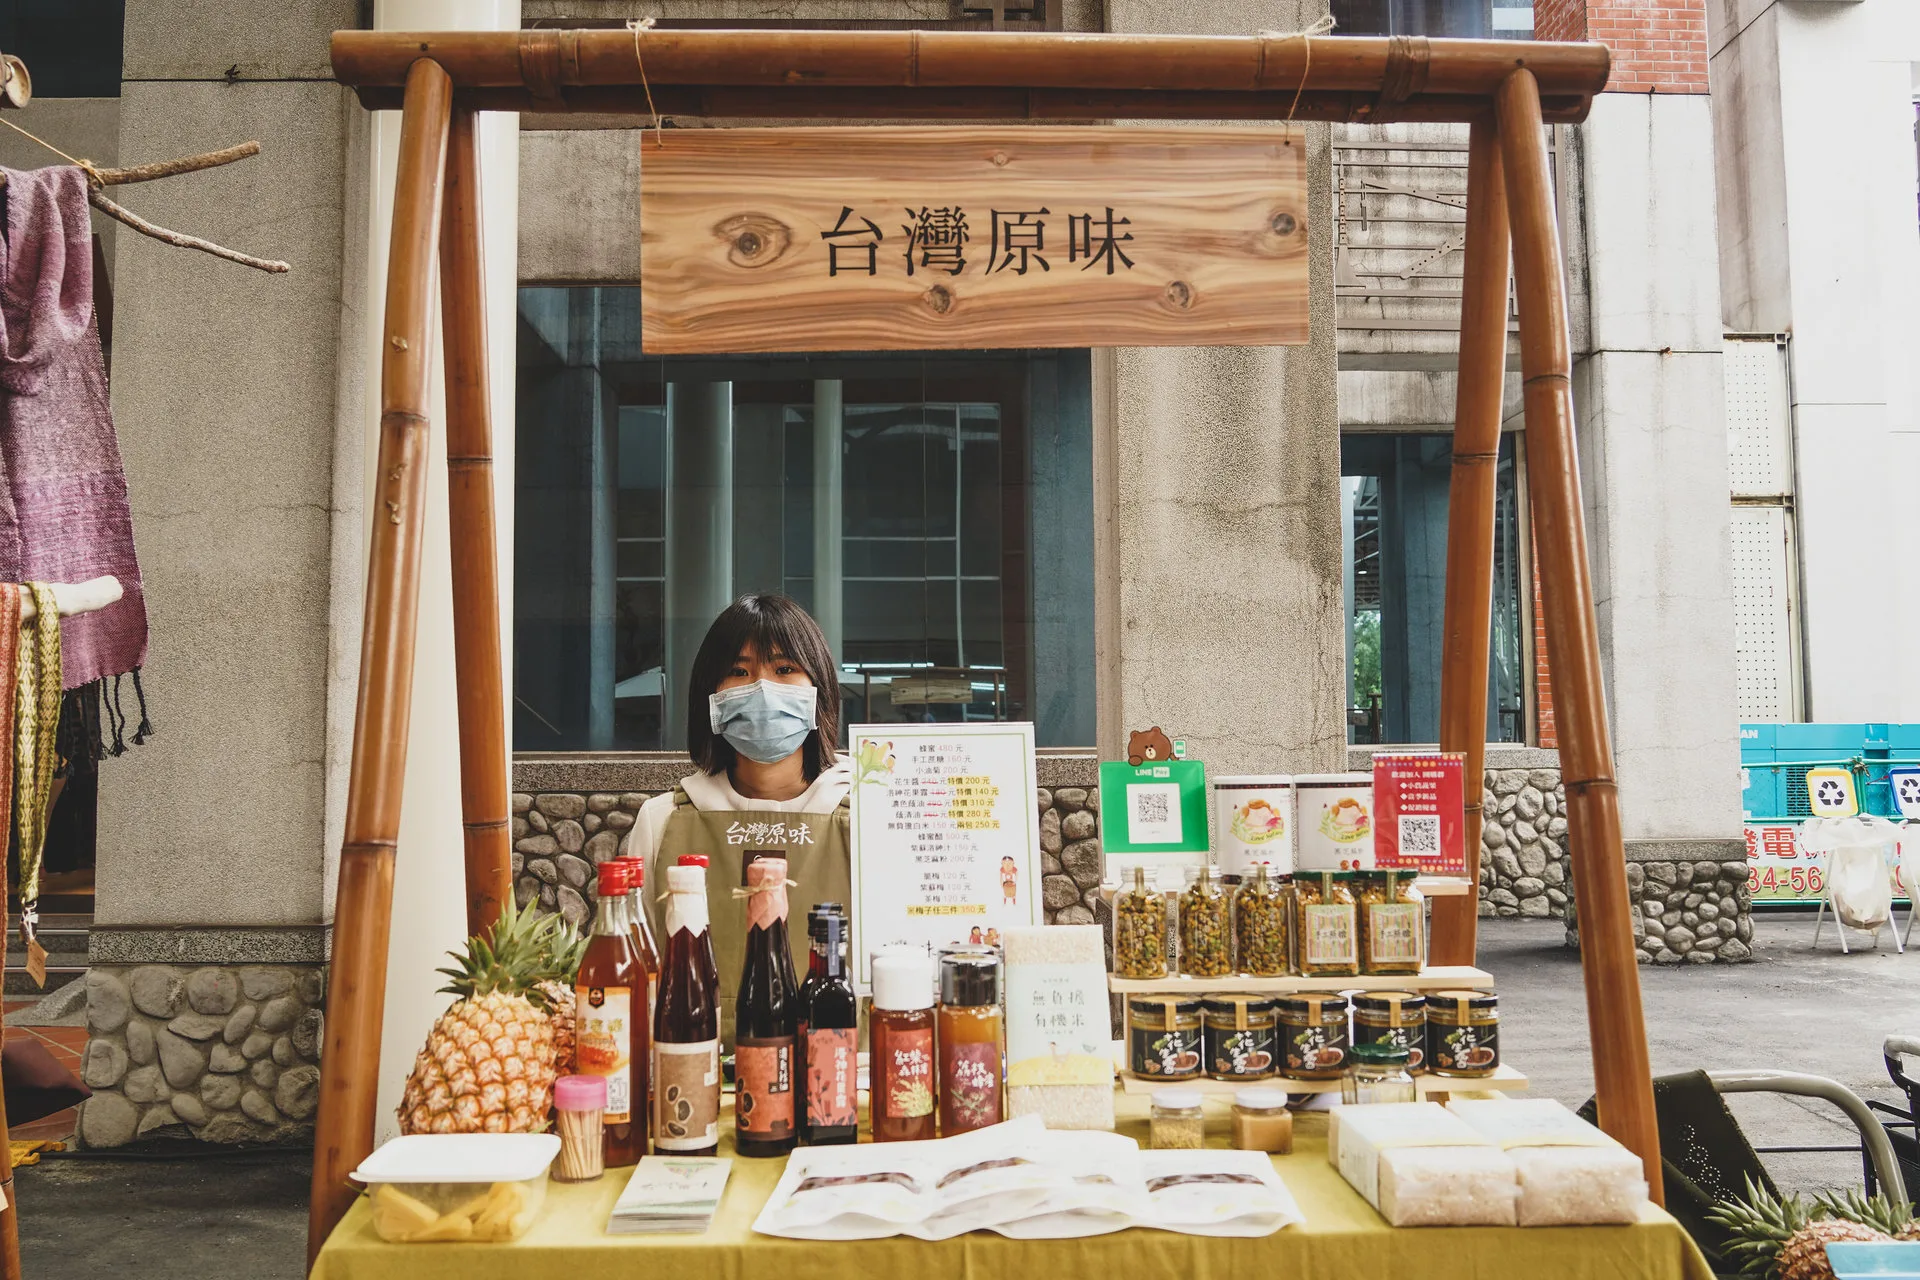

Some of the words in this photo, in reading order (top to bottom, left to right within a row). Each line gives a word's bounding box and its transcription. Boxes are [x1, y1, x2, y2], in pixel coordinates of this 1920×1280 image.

[819, 205, 1135, 278] 台灣原味
[991, 788, 1000, 796] 元
[983, 810, 992, 818] 元
[725, 821, 815, 846] 台灣原味
[977, 905, 986, 914] 元
[1034, 1012, 1085, 1028] 有機米
